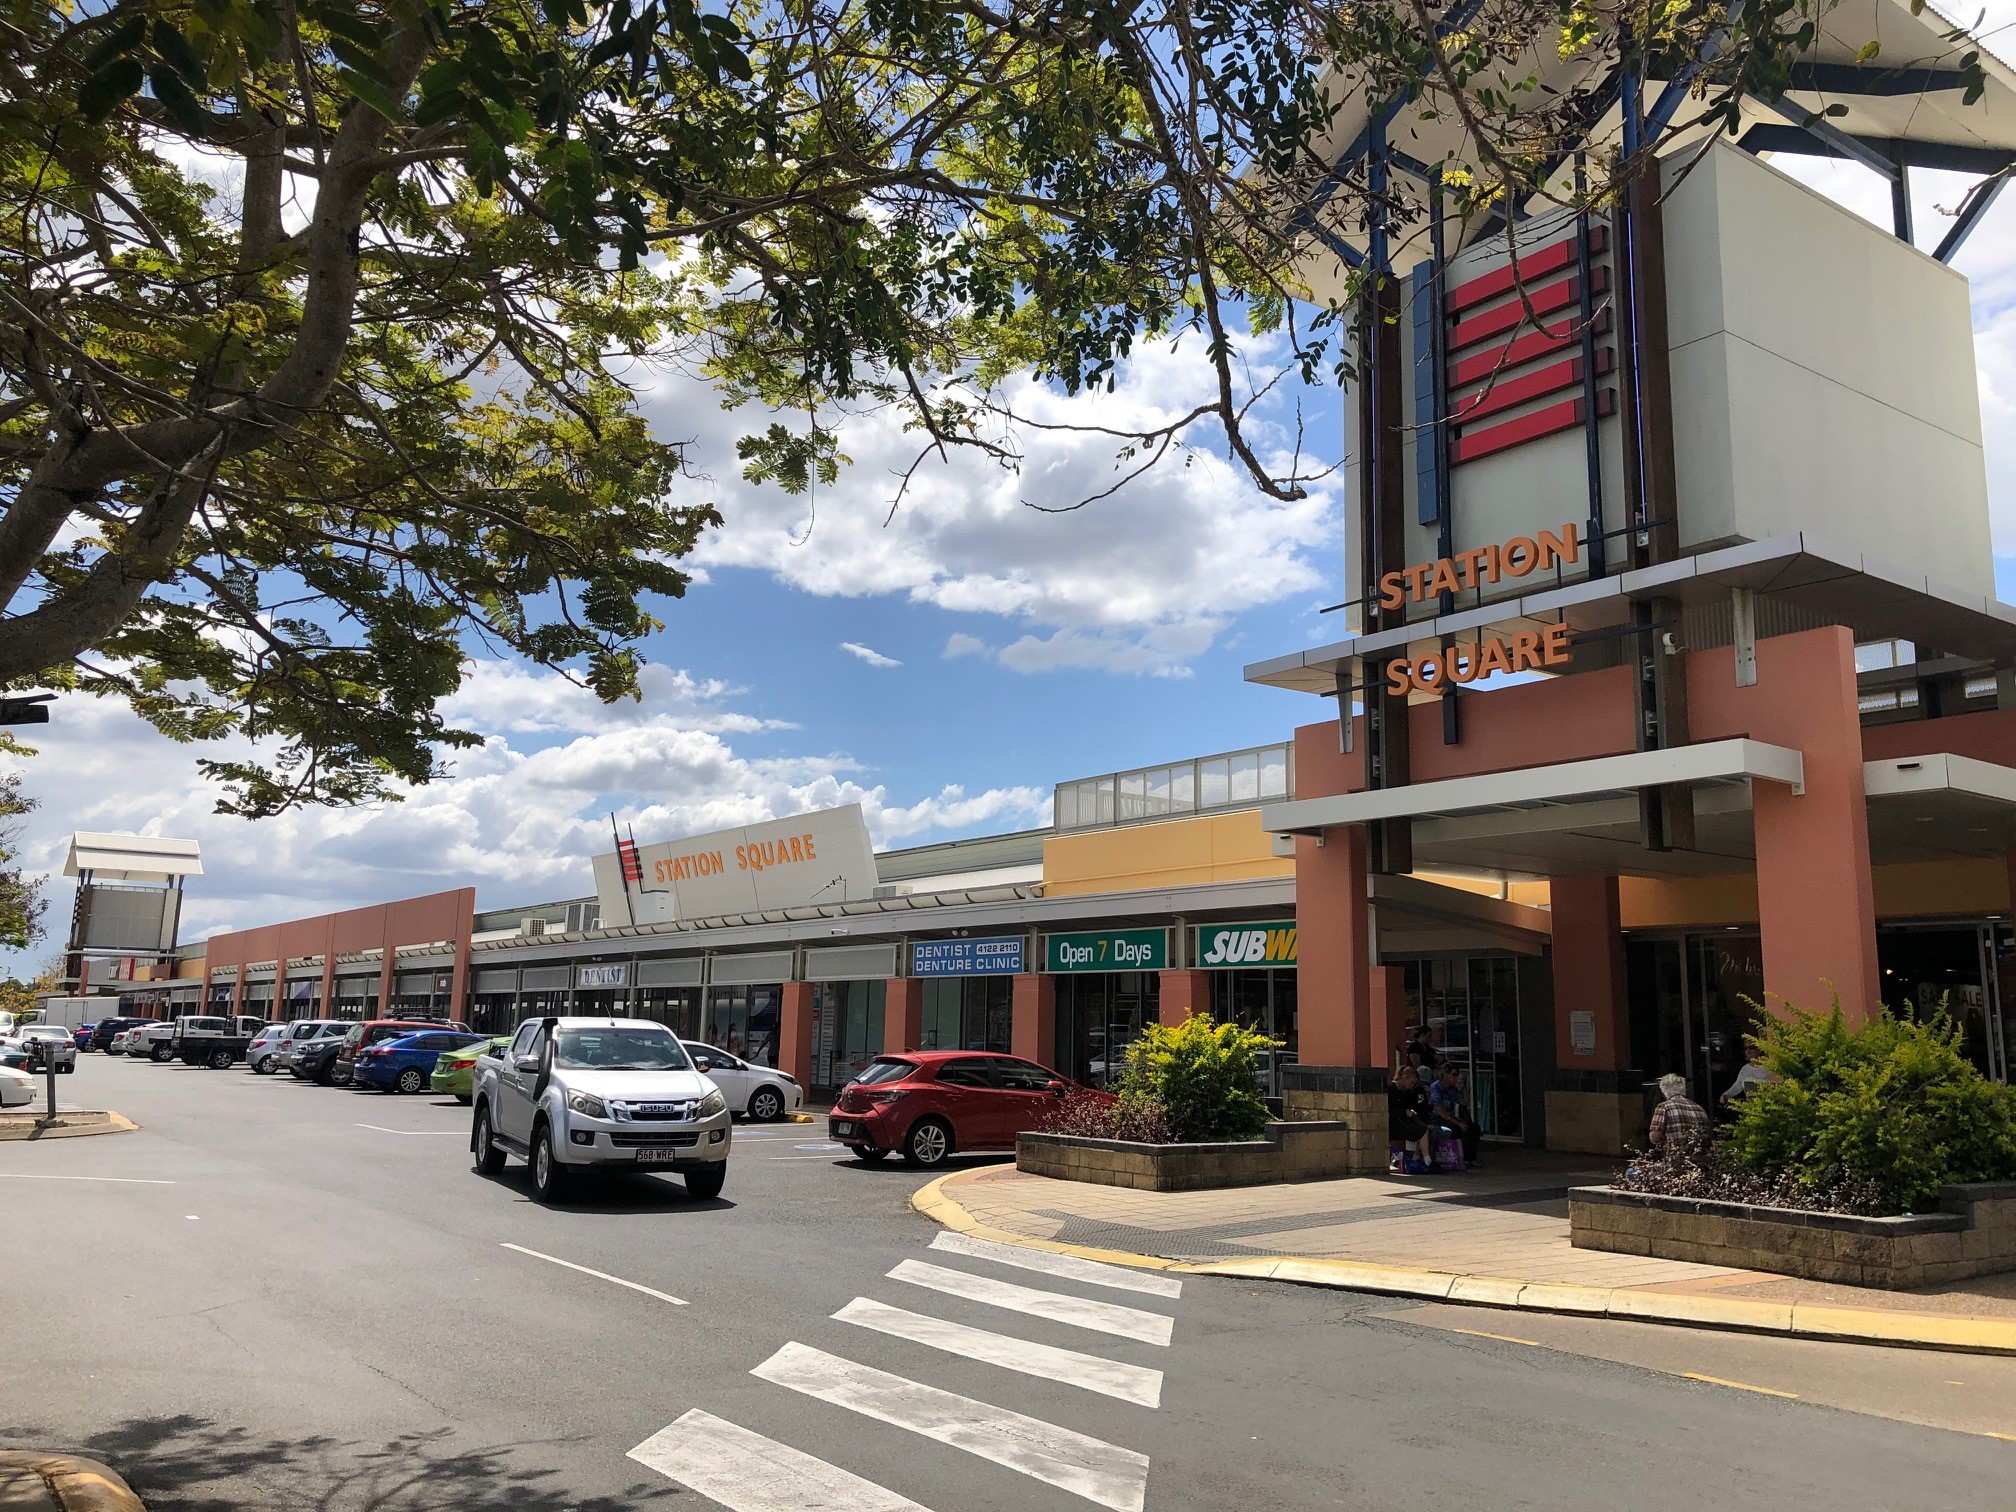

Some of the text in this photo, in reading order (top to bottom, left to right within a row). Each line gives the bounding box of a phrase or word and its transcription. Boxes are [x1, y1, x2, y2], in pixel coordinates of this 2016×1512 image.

[1380, 522, 1578, 610] STATION
[1386, 623, 1571, 696] SQUARE
[655, 833, 817, 883] STATION SQUARE
[916, 944, 971, 958] DENTIST
[1060, 939, 1152, 969] Open 7 Days
[1203, 928, 1297, 964] SUBW
[584, 968, 622, 984] DENTIST
[916, 957, 1020, 972] DENTURE CLINIC
[641, 1104, 672, 1112] ISUZU
